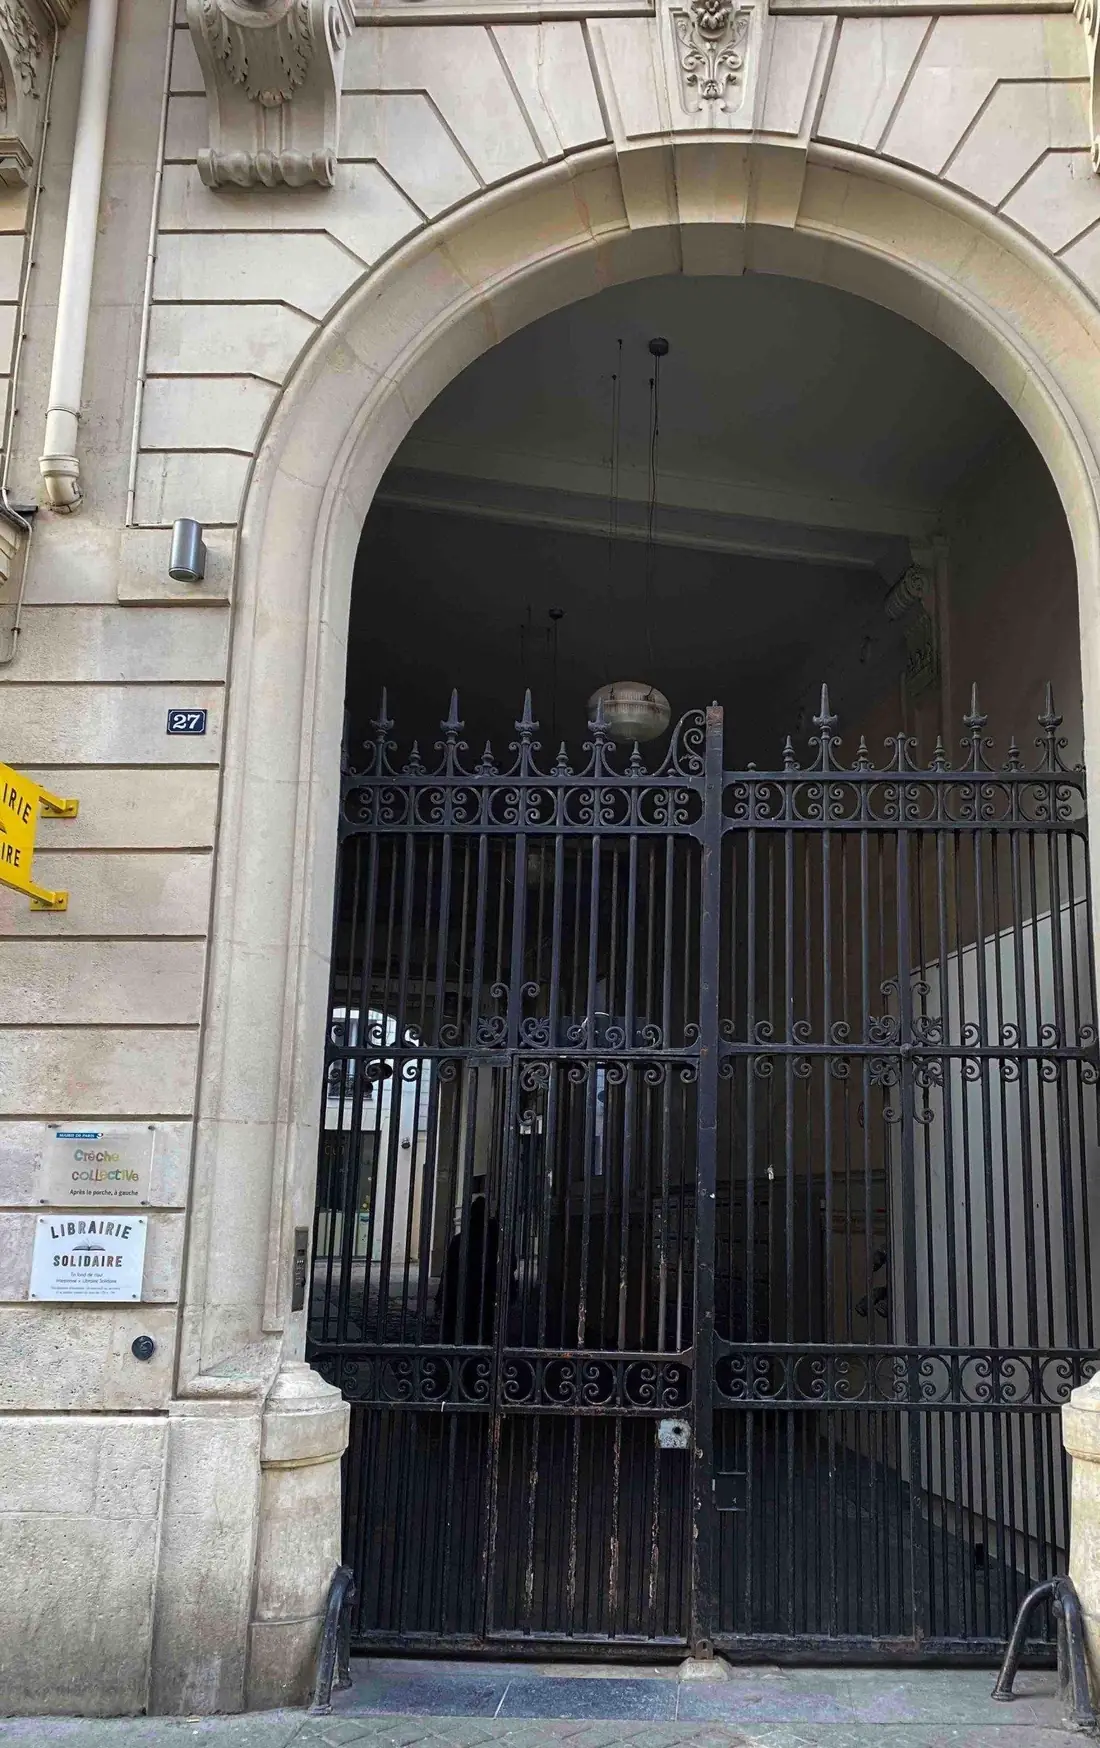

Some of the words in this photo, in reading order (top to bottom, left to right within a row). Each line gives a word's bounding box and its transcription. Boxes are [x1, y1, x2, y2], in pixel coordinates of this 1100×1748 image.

[172, 714, 201, 730] 27
[92, 1189, 113, 1197] porche,
[118, 1189, 139, 1197] gauche
[50, 1220, 132, 1239] LIBRAIRIE
[53, 1255, 123, 1267] SOLIDAIRE
